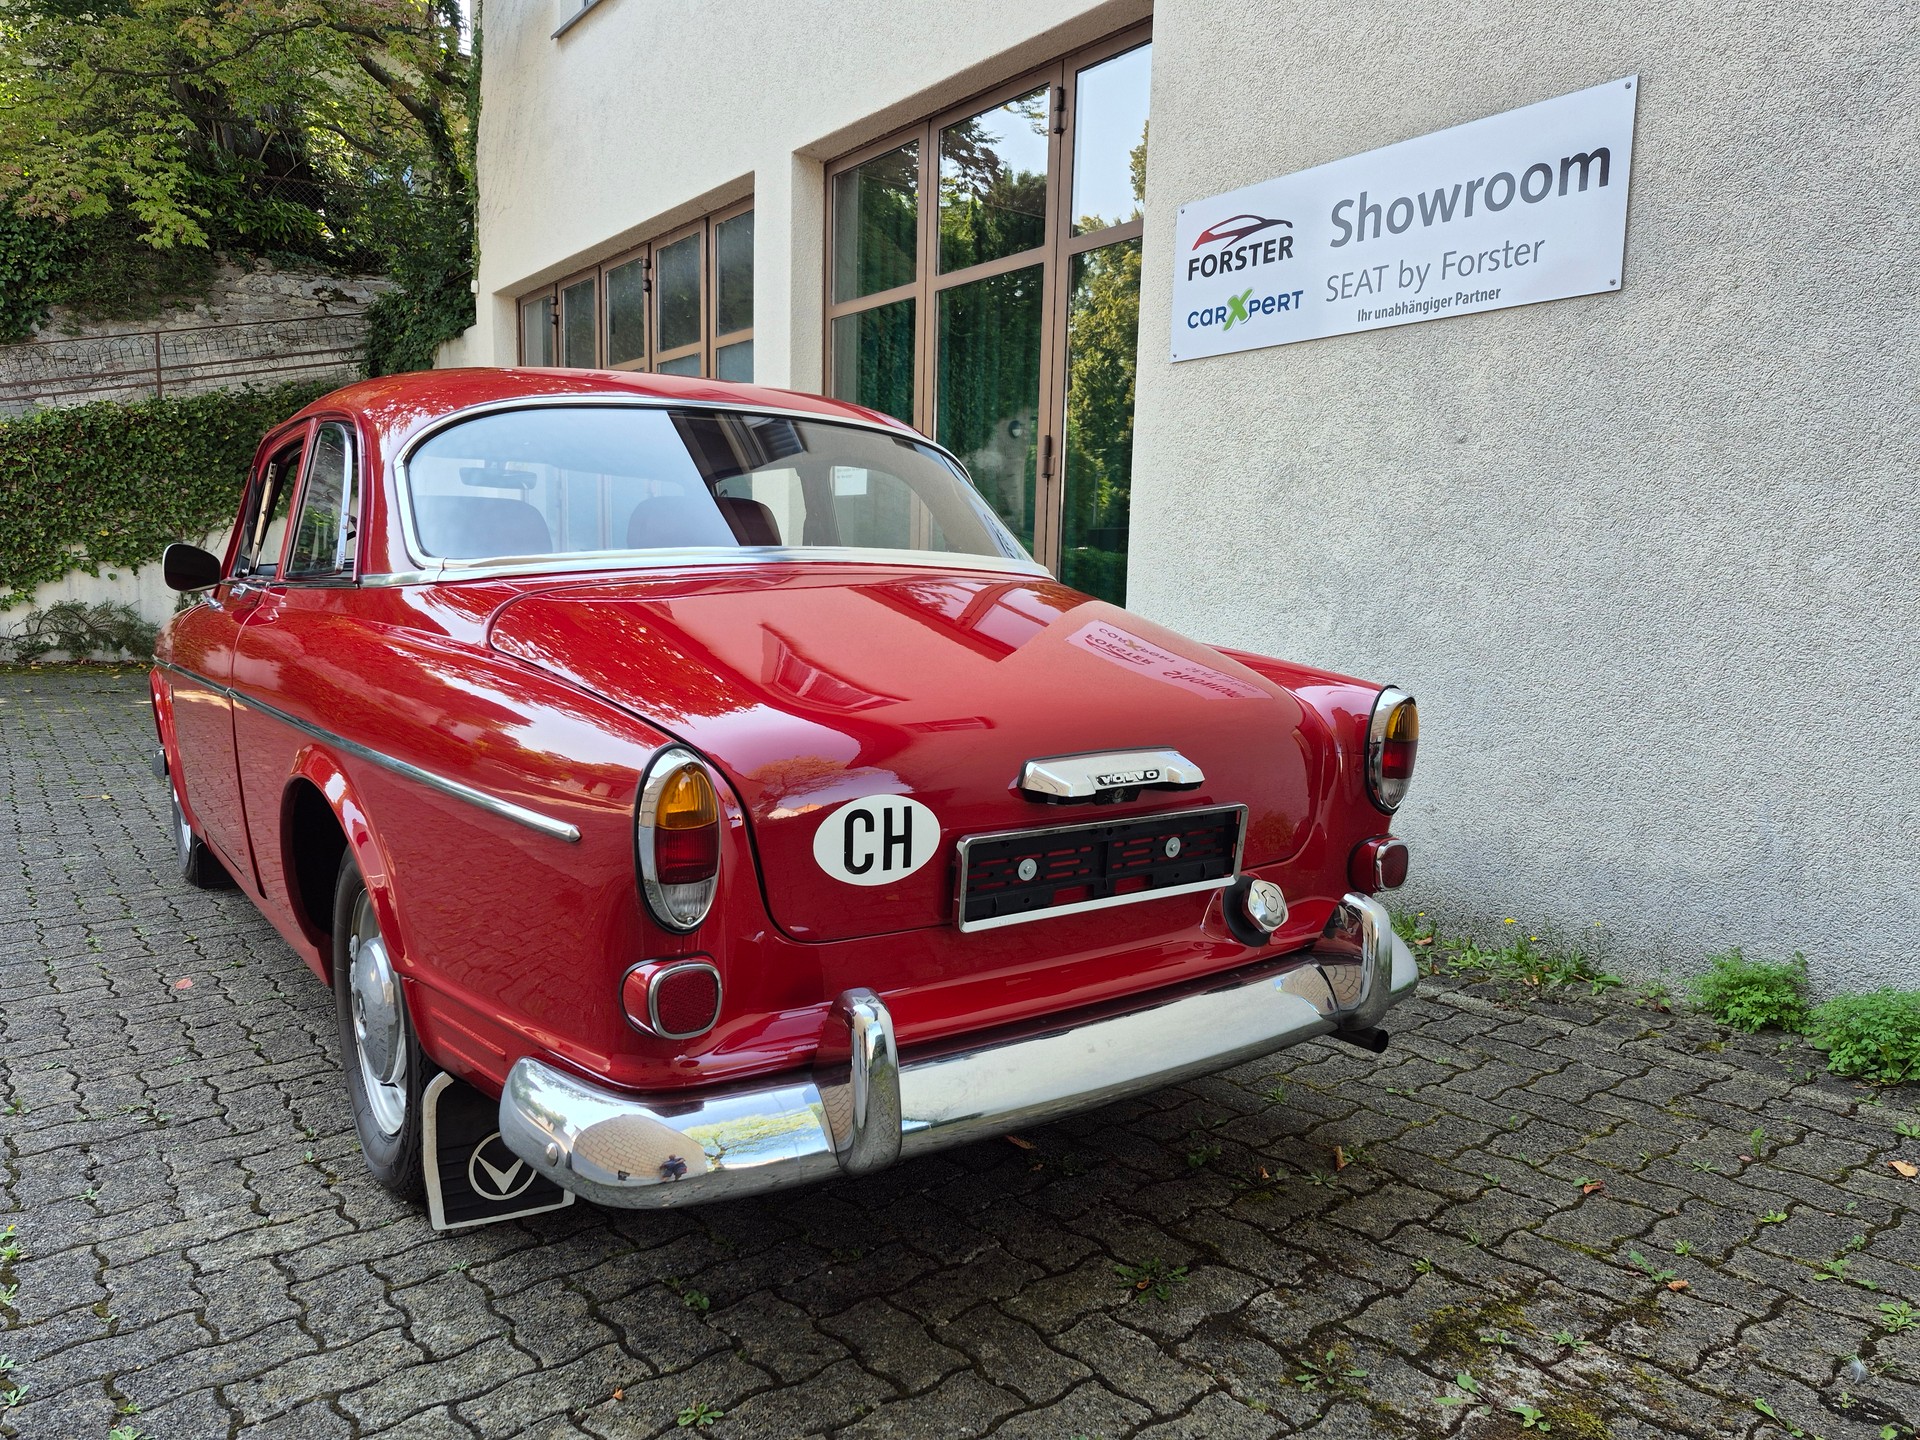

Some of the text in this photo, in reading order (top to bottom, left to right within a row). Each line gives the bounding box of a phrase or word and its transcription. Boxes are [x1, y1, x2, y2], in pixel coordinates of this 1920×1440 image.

[1330, 146, 1611, 248] Showroom
[1187, 235, 1294, 281] FORSTER
[1326, 239, 1545, 302] SEAT by Forster
[1357, 288, 1501, 322] Ihr unabhängiger Partner
[1098, 769, 1158, 785] VOLVO
[843, 806, 912, 874] CH
